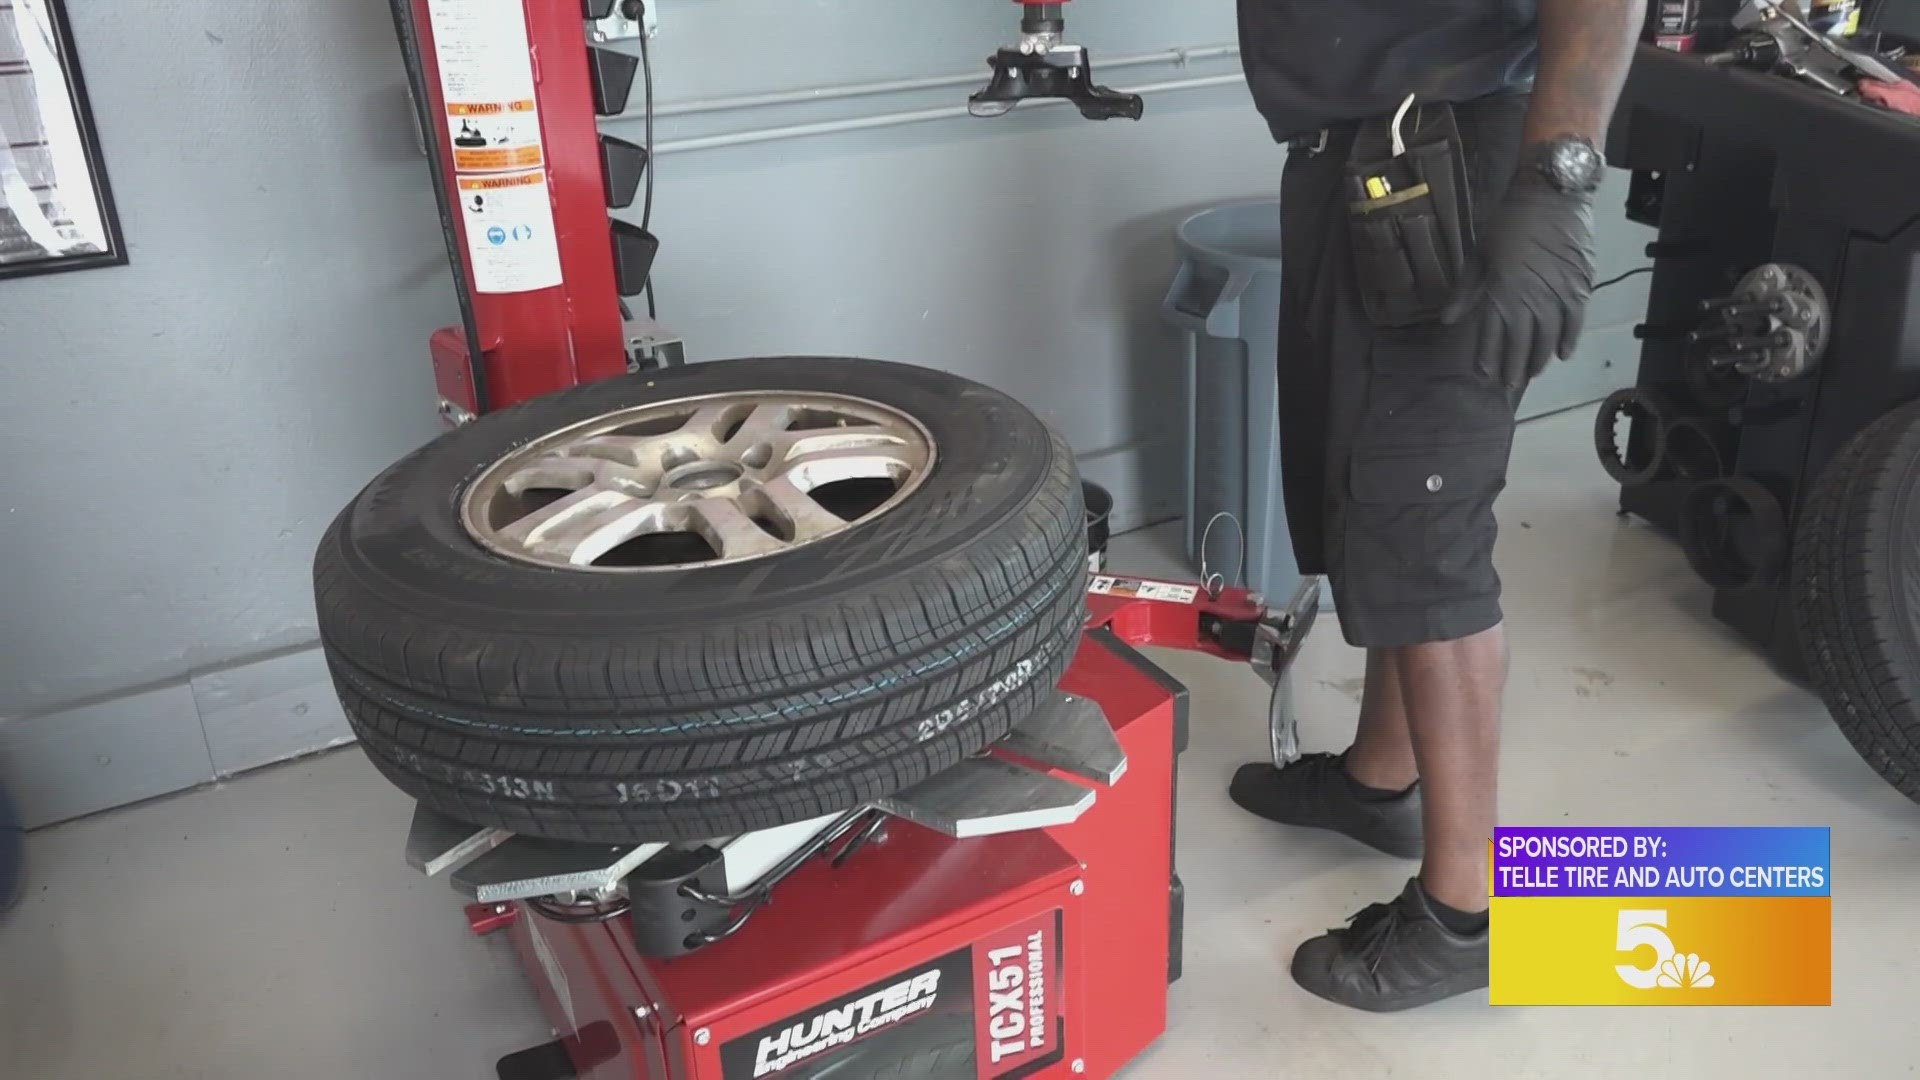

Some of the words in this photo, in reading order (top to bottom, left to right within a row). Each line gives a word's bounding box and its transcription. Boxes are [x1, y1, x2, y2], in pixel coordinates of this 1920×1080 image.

[467, 101, 523, 114] WARNNG
[481, 175, 532, 189] WARNING
[756, 968, 942, 1062] HUNTER
[857, 992, 938, 1035] Company
[987, 944, 1026, 1063] TCX51
[1027, 929, 1045, 1048] PROFESSIONAL
